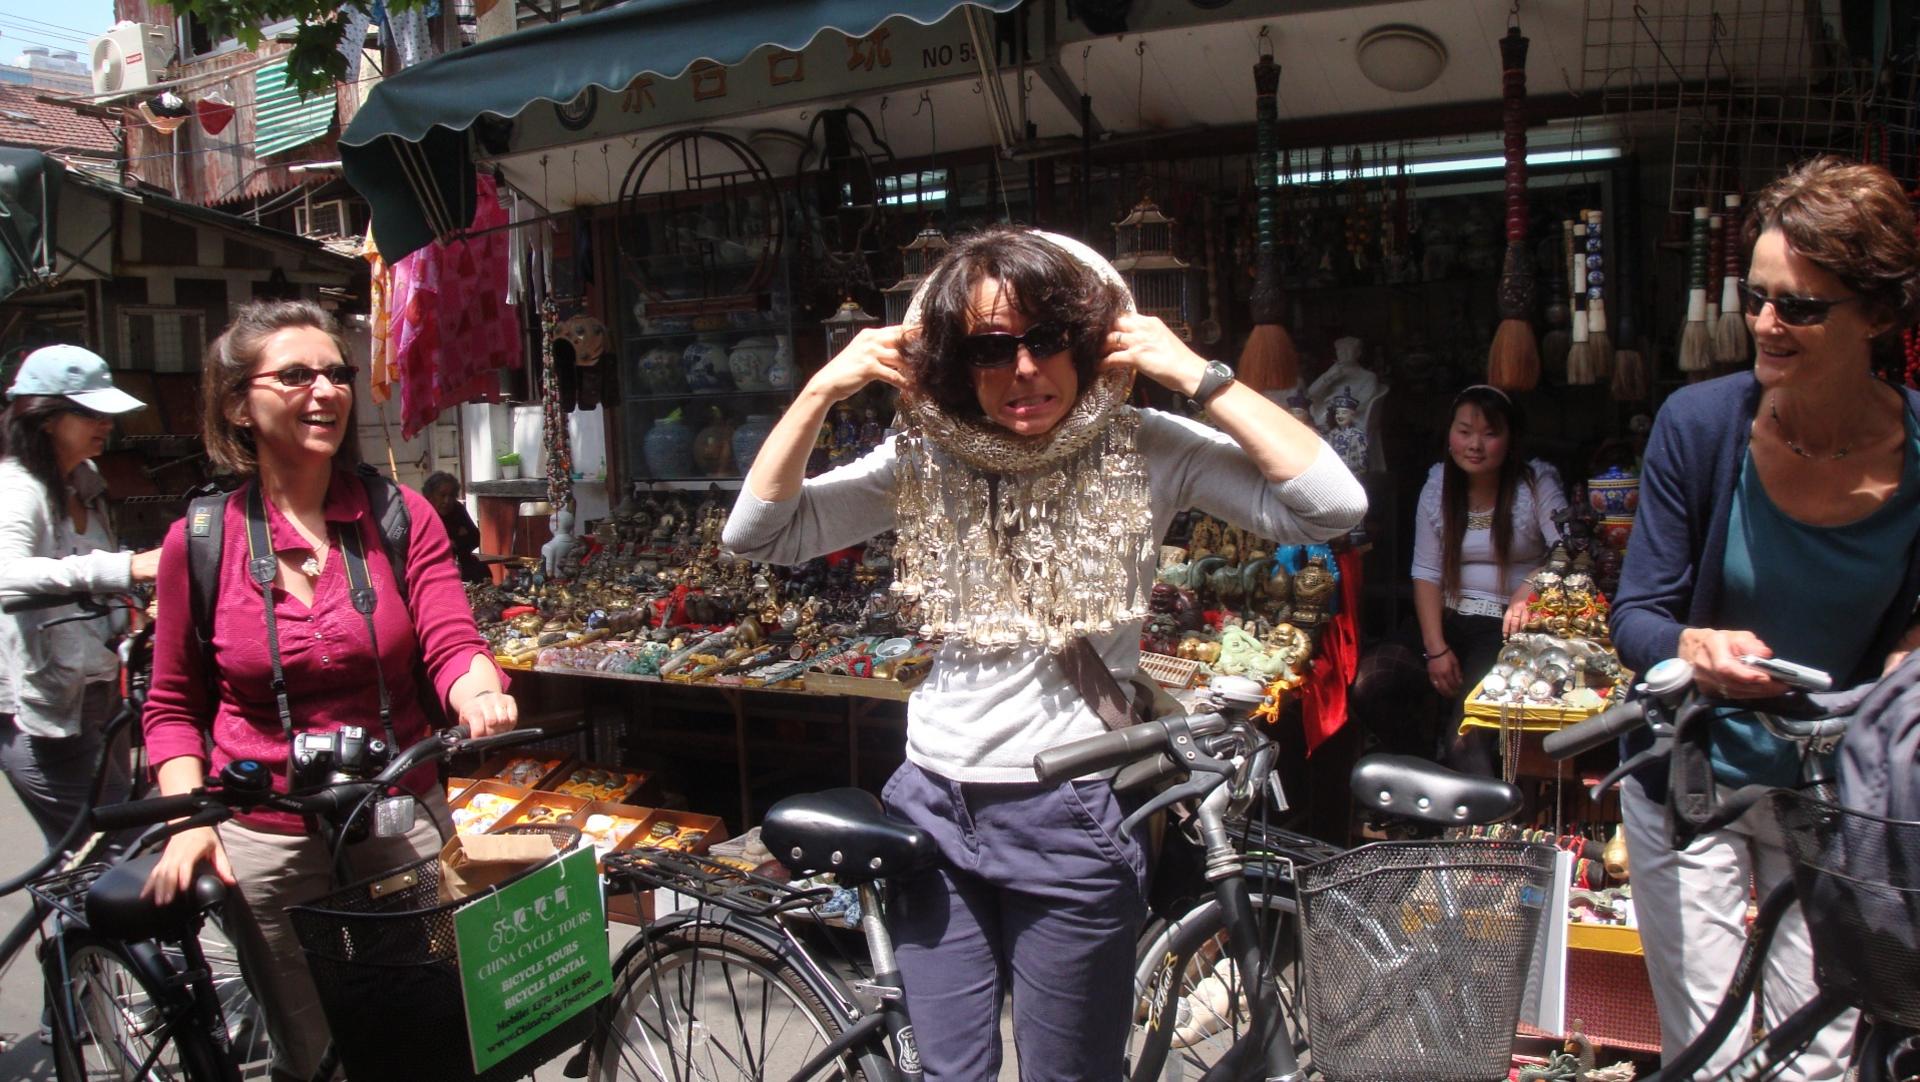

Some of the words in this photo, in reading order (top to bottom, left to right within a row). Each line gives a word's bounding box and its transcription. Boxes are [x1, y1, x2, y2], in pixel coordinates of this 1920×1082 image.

[922, 44, 953, 68] NO
[478, 950, 516, 981] CHINA
[518, 929, 554, 958] CYCLE
[558, 907, 592, 936] TOURS
[501, 960, 544, 993] BICYCLE
[545, 940, 579, 967] TOURS
[504, 978, 546, 1010] BICYCLE
[548, 955, 587, 984] RENTAL
